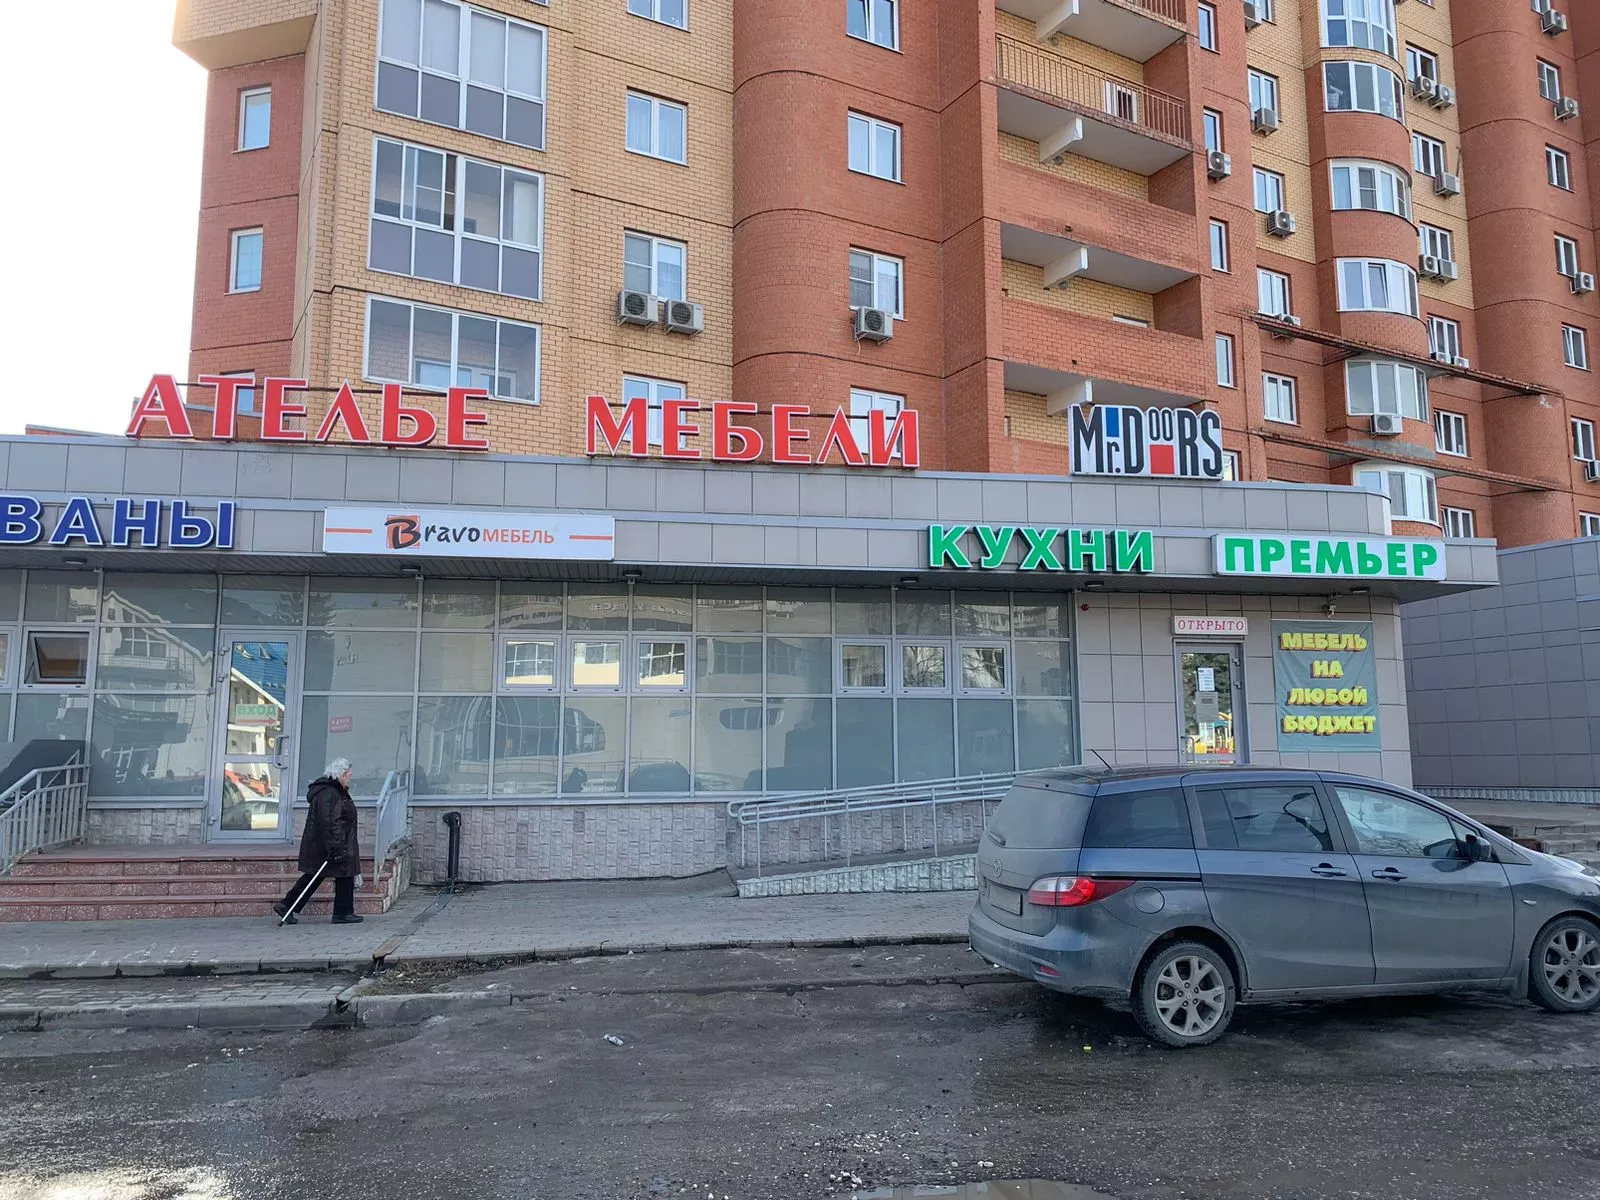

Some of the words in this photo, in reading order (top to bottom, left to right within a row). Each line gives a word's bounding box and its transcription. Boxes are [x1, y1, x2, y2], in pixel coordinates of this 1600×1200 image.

[125, 374, 489, 449] АТЕЛЬЕ
[586, 395, 920, 469] МЕБЕЛИ
[0, 494, 236, 549] ВАНЫ
[928, 524, 1154, 573] КУХНИ
[1225, 537, 1438, 577] ПРЕМЬЕР
[1177, 618, 1245, 632] ОТКРЫТО
[1280, 632, 1368, 651] МЕБЕЛЬ
[1311, 660, 1344, 679] НА
[1288, 685, 1368, 706] ЛЮБОЙ
[237, 704, 277, 717] ВХОД
[1283, 715, 1377, 736] БЮДЖЕТ
